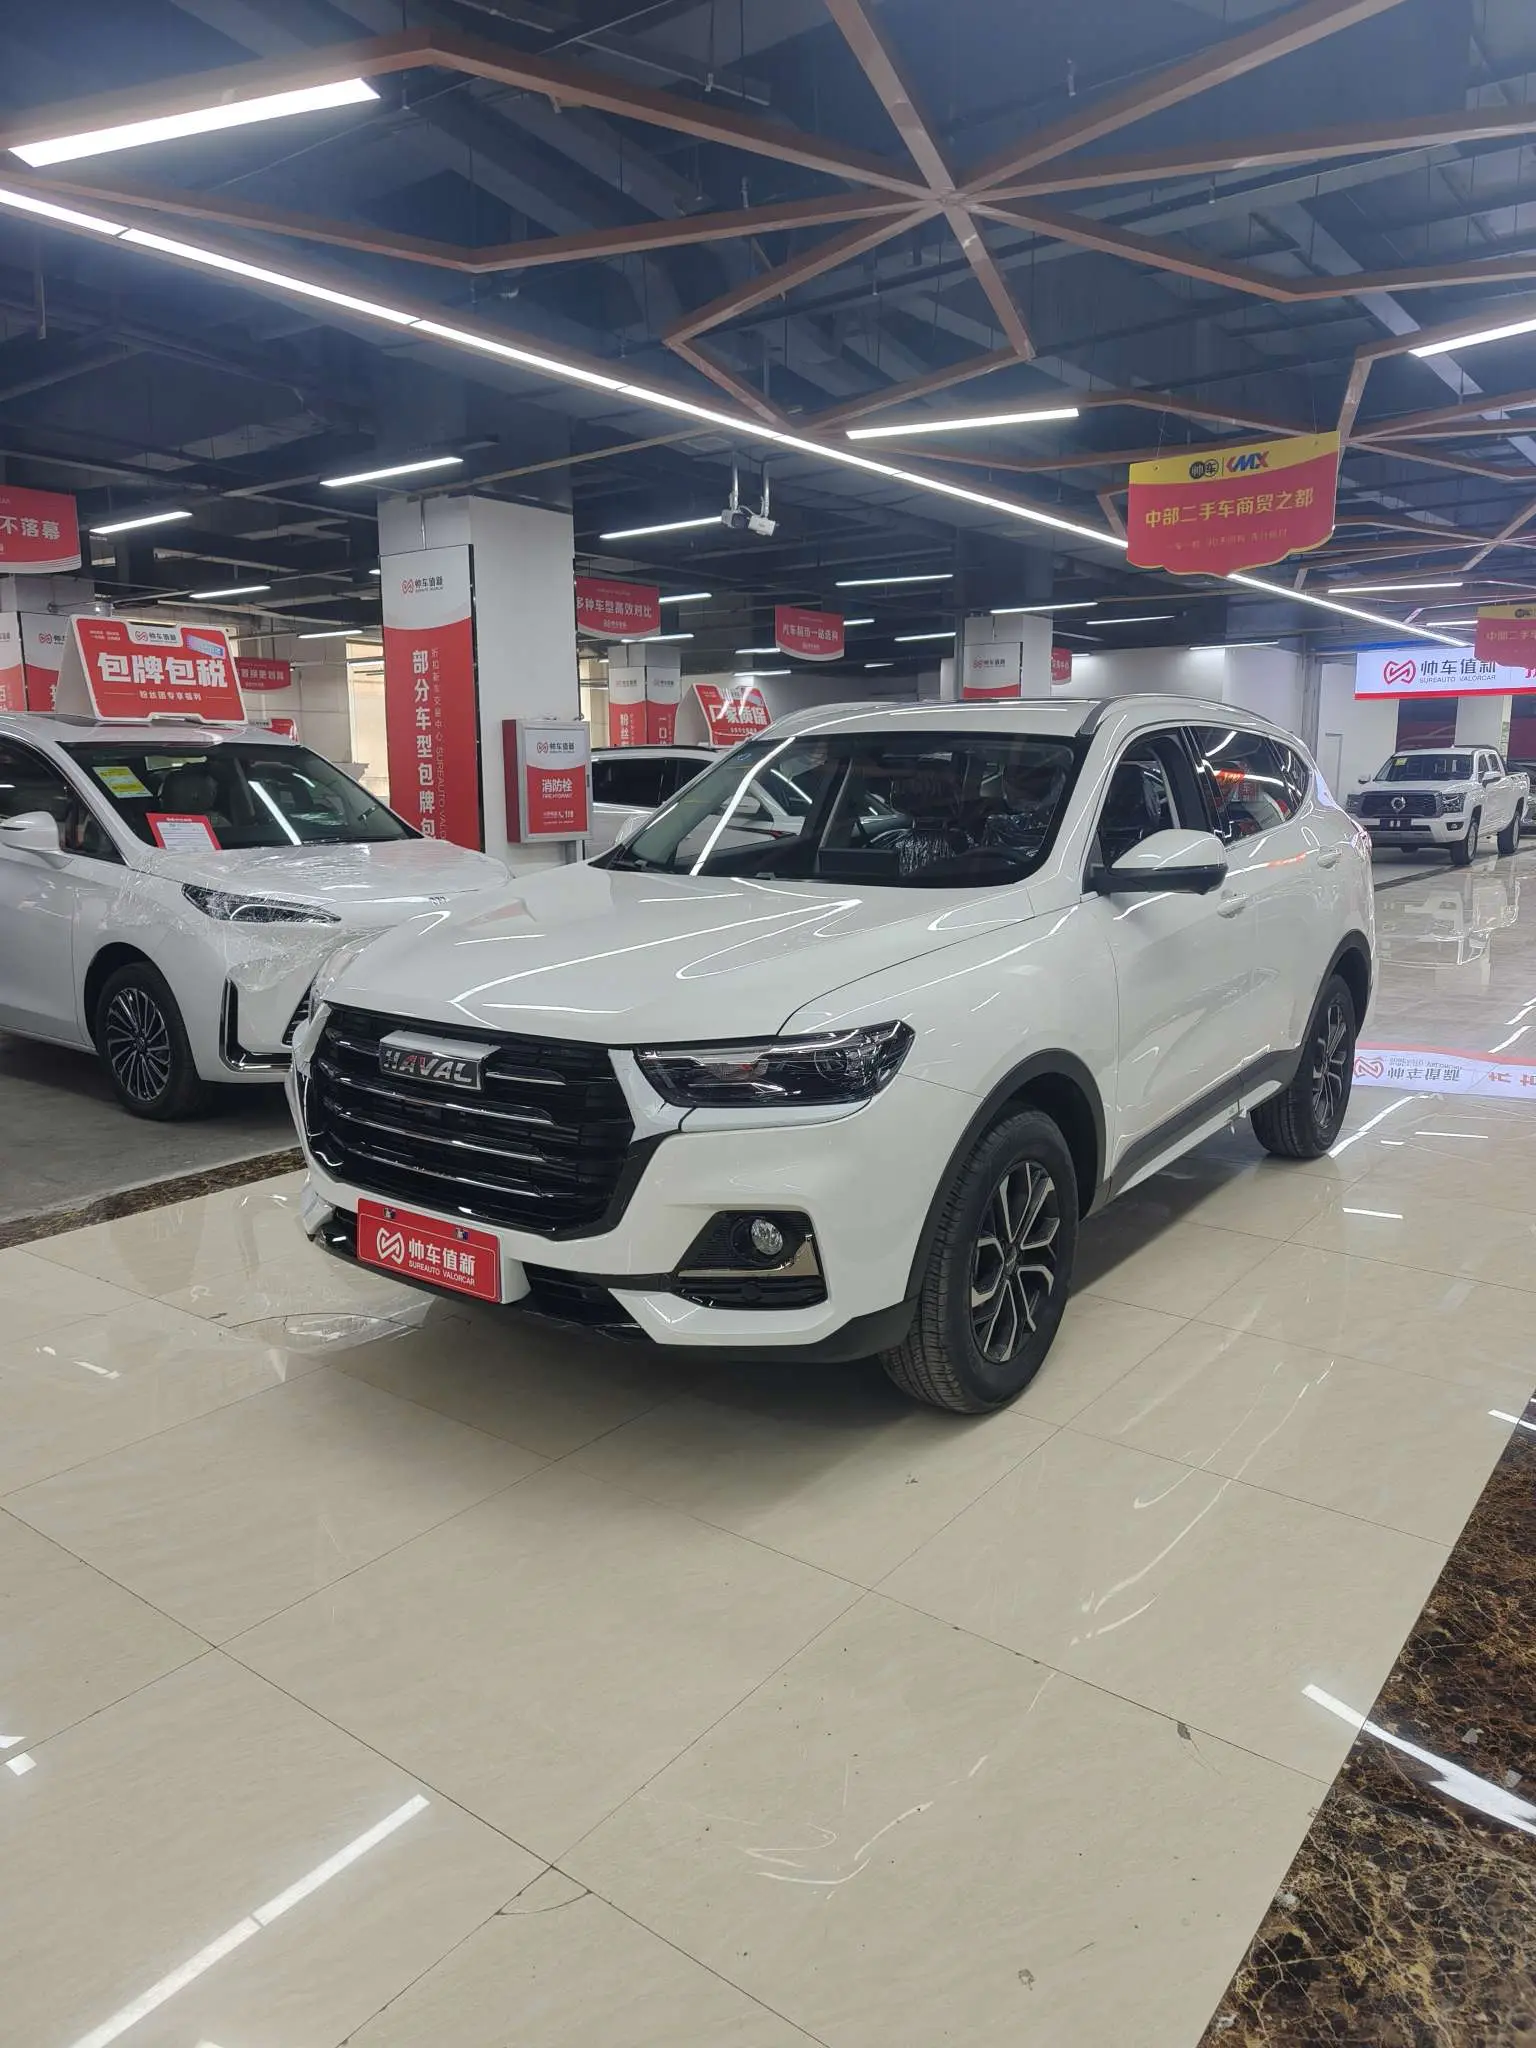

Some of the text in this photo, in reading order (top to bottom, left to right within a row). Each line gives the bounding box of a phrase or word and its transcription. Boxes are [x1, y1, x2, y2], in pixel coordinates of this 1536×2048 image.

[1145, 487, 1314, 528] 中部二手车商贸之都
[0, 515, 60, 541] 不落幕
[97, 652, 228, 688] 包牌包税
[1420, 674, 1496, 684] SUREAUTO VALORCAR
[709, 704, 768, 726] 厂家质保
[412, 650, 436, 839] 部分车型包牌包
[542, 778, 573, 793] 消防栓
[383, 1051, 473, 1083] HAVAL
[408, 1238, 476, 1277] 帅车值新
[408, 1260, 475, 1287] SUREAUTO VALORCAR
